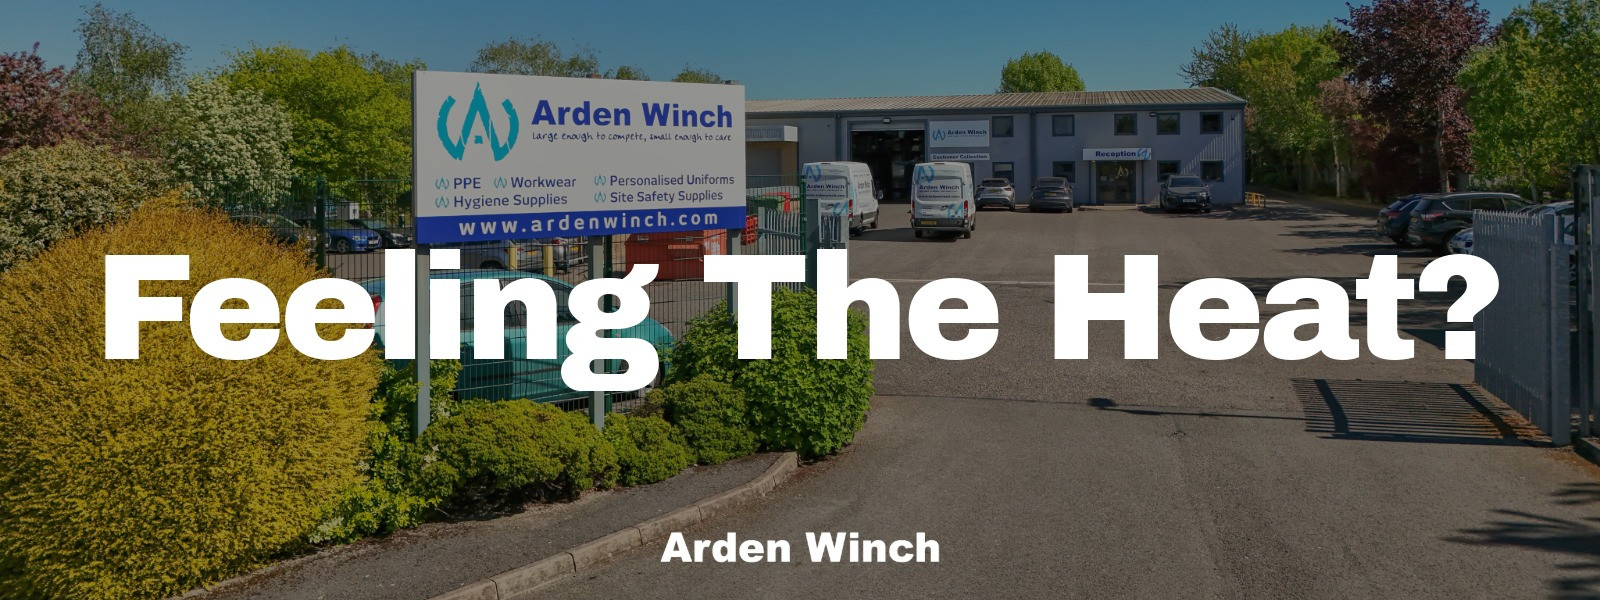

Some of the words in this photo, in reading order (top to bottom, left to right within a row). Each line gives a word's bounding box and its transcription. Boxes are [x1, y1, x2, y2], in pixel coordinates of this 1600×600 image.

[531, 100, 631, 126] Arden
[642, 102, 733, 128] Winch
[532, 131, 558, 143] large
[562, 132, 594, 143] enough
[596, 131, 606, 141] to
[608, 132, 647, 143] compete,
[649, 132, 672, 142] small
[674, 132, 703, 143] enough
[704, 132, 714, 142] to
[715, 133, 732, 142] care
[1095, 150, 1137, 158] Reception
[453, 177, 481, 190] PPE
[510, 176, 577, 189] Workwear
[610, 174, 684, 187] Personalised
[686, 173, 735, 186] Uniforms
[454, 195, 510, 210] Hygiene
[513, 193, 568, 208] Supplies
[610, 191, 634, 204] Site
[637, 190, 675, 204] Safety
[678, 189, 724, 203] Supplies
[458, 211, 719, 237] www.ardenwinch.com
